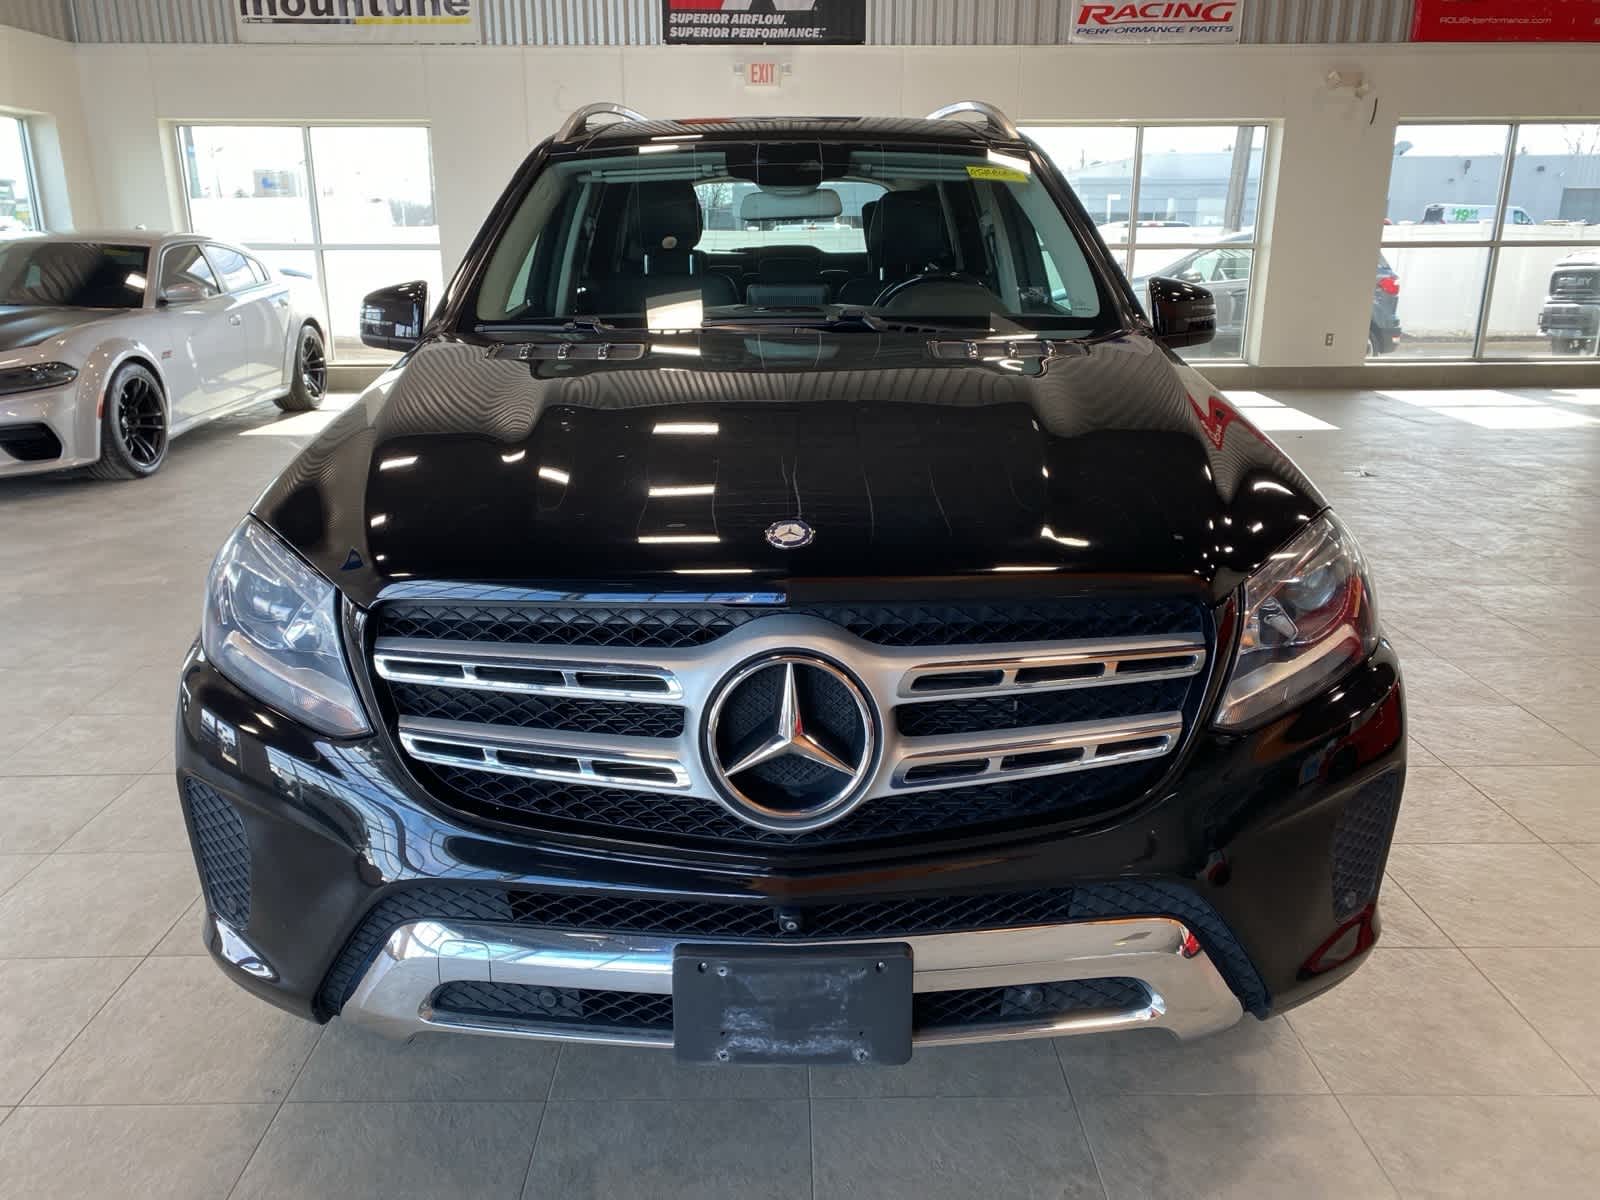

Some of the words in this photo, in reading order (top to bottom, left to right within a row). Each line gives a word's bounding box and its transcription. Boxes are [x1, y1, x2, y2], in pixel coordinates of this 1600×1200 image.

[669, 13, 730, 25] SUPERIOR
[731, 13, 787, 25] AIRFLOW.
[1077, 2, 1237, 25] RACING
[669, 26, 730, 38] SUPERIOR
[1076, 26, 1185, 35] PERFORMANCE
[1189, 25, 1233, 33] PARTS
[751, 63, 776, 83] EXIT
